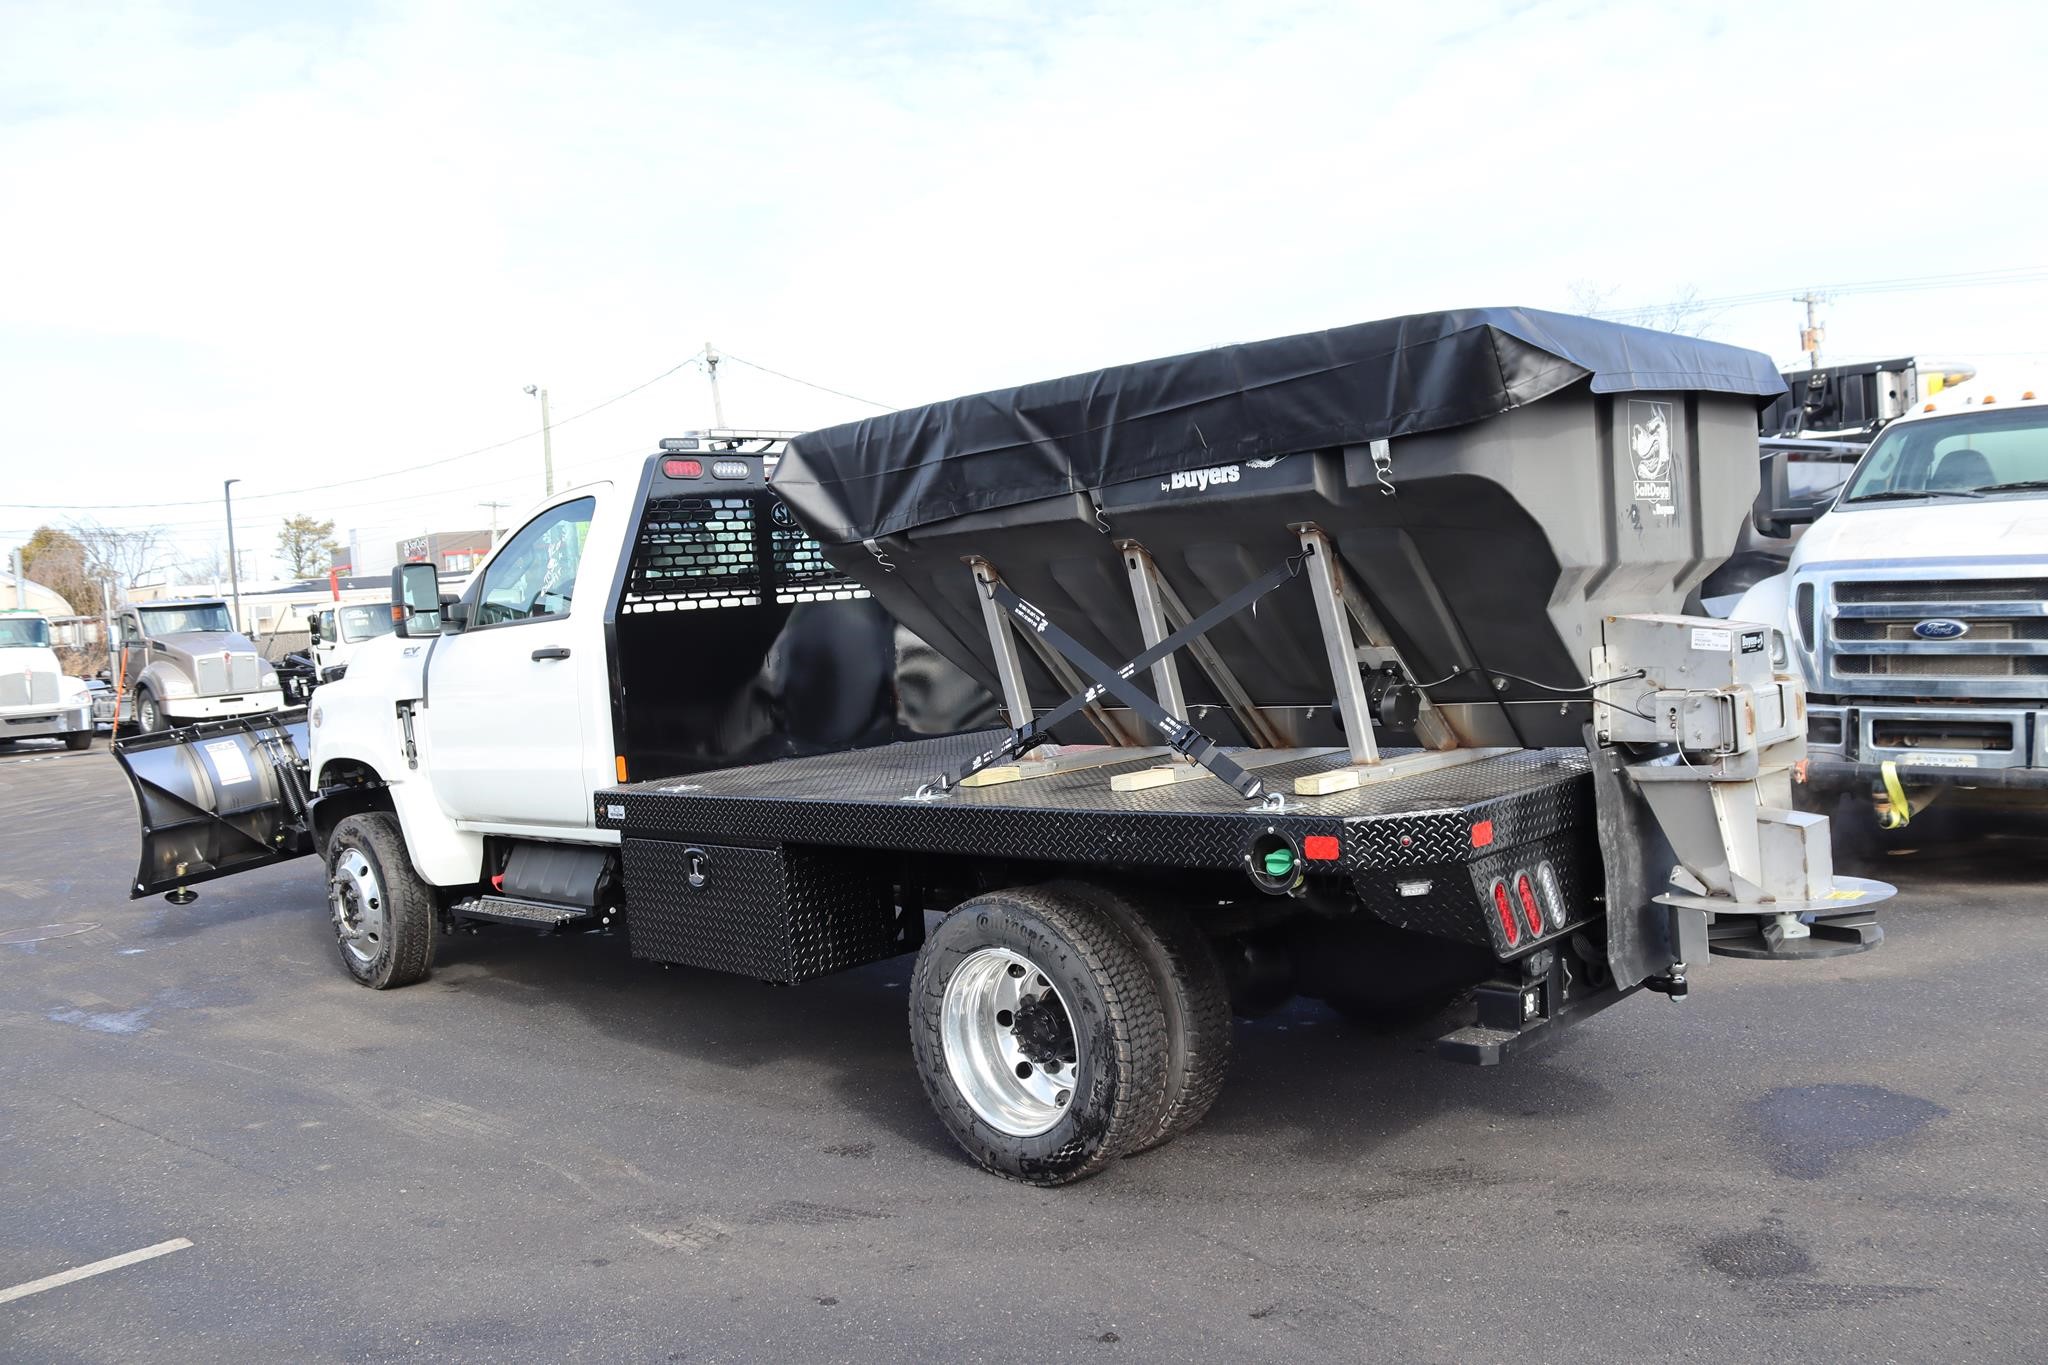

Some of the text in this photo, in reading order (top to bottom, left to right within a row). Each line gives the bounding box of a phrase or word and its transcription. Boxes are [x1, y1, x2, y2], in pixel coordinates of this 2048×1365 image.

[1161, 464, 1241, 492] by Buyers
[1635, 482, 1670, 499] SaltDogg
